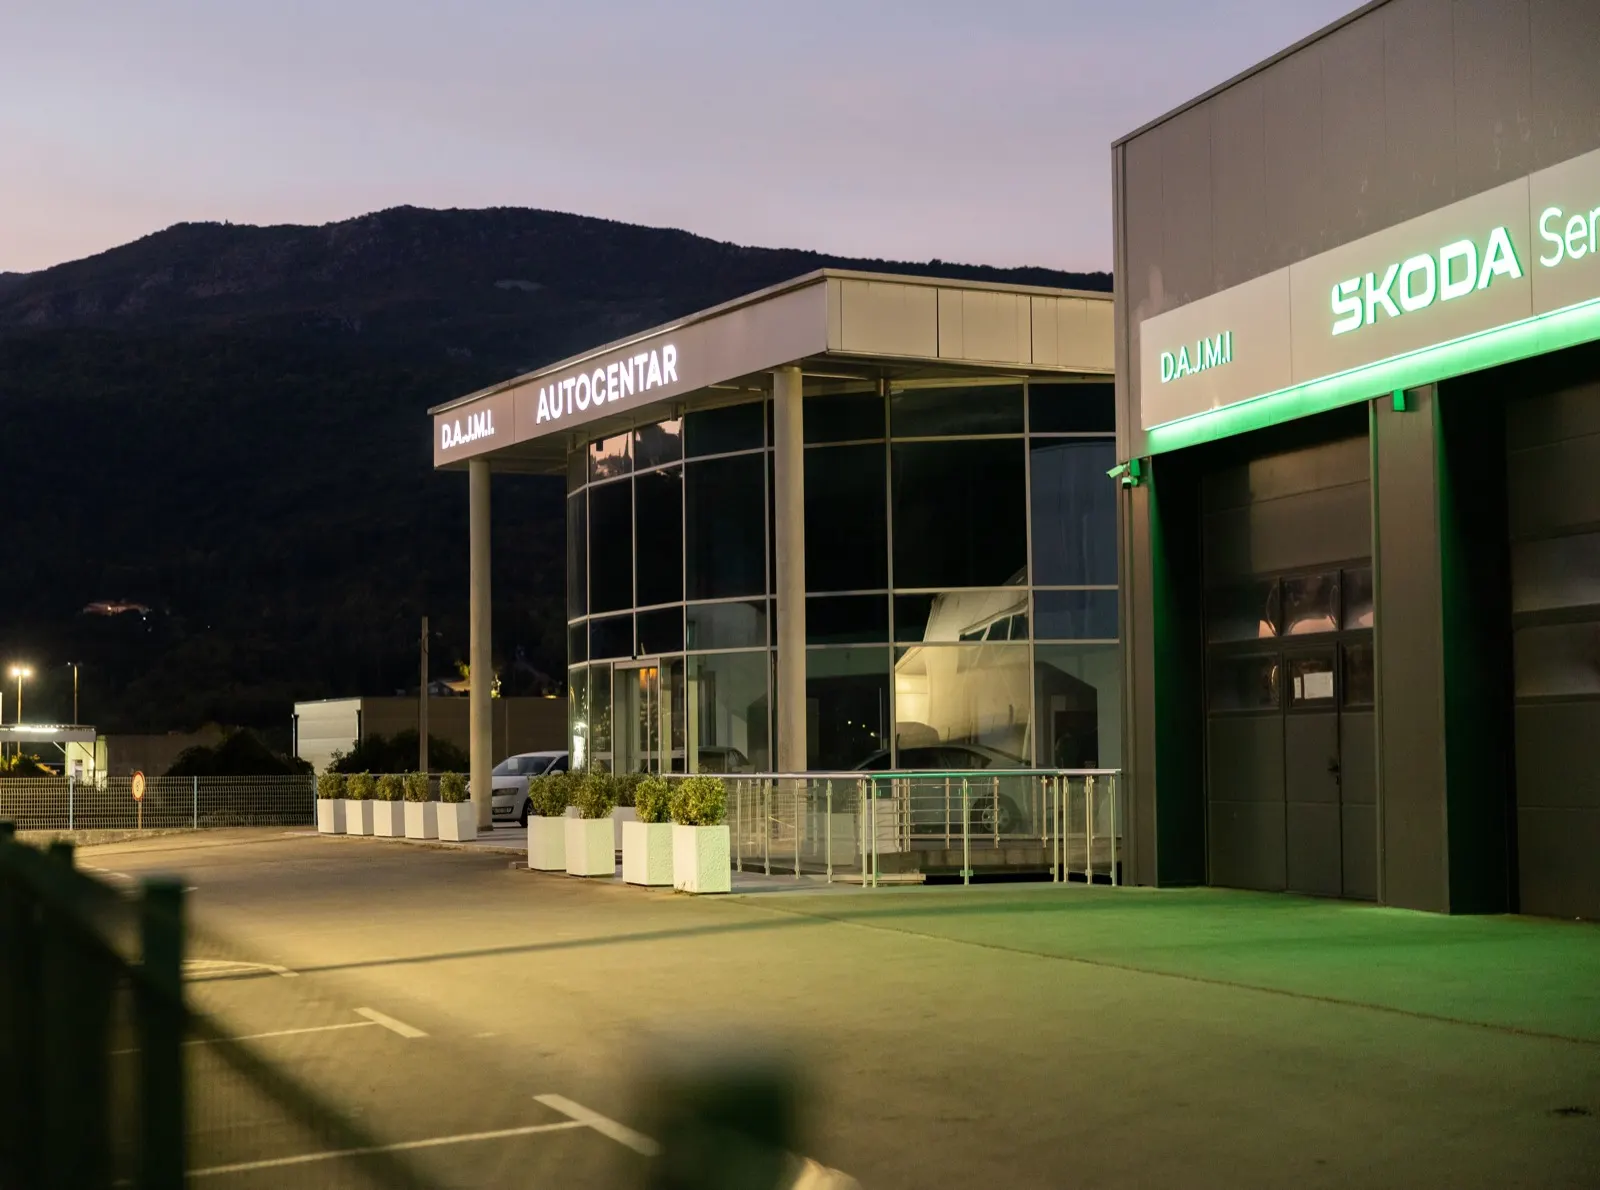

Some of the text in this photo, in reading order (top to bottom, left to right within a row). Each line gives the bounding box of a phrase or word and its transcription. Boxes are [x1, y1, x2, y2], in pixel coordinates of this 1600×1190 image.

[1331, 226, 1523, 335] SKODA
[536, 344, 678, 424] AUTOCENTAR
[1161, 331, 1232, 384] D.A.J.M.I
